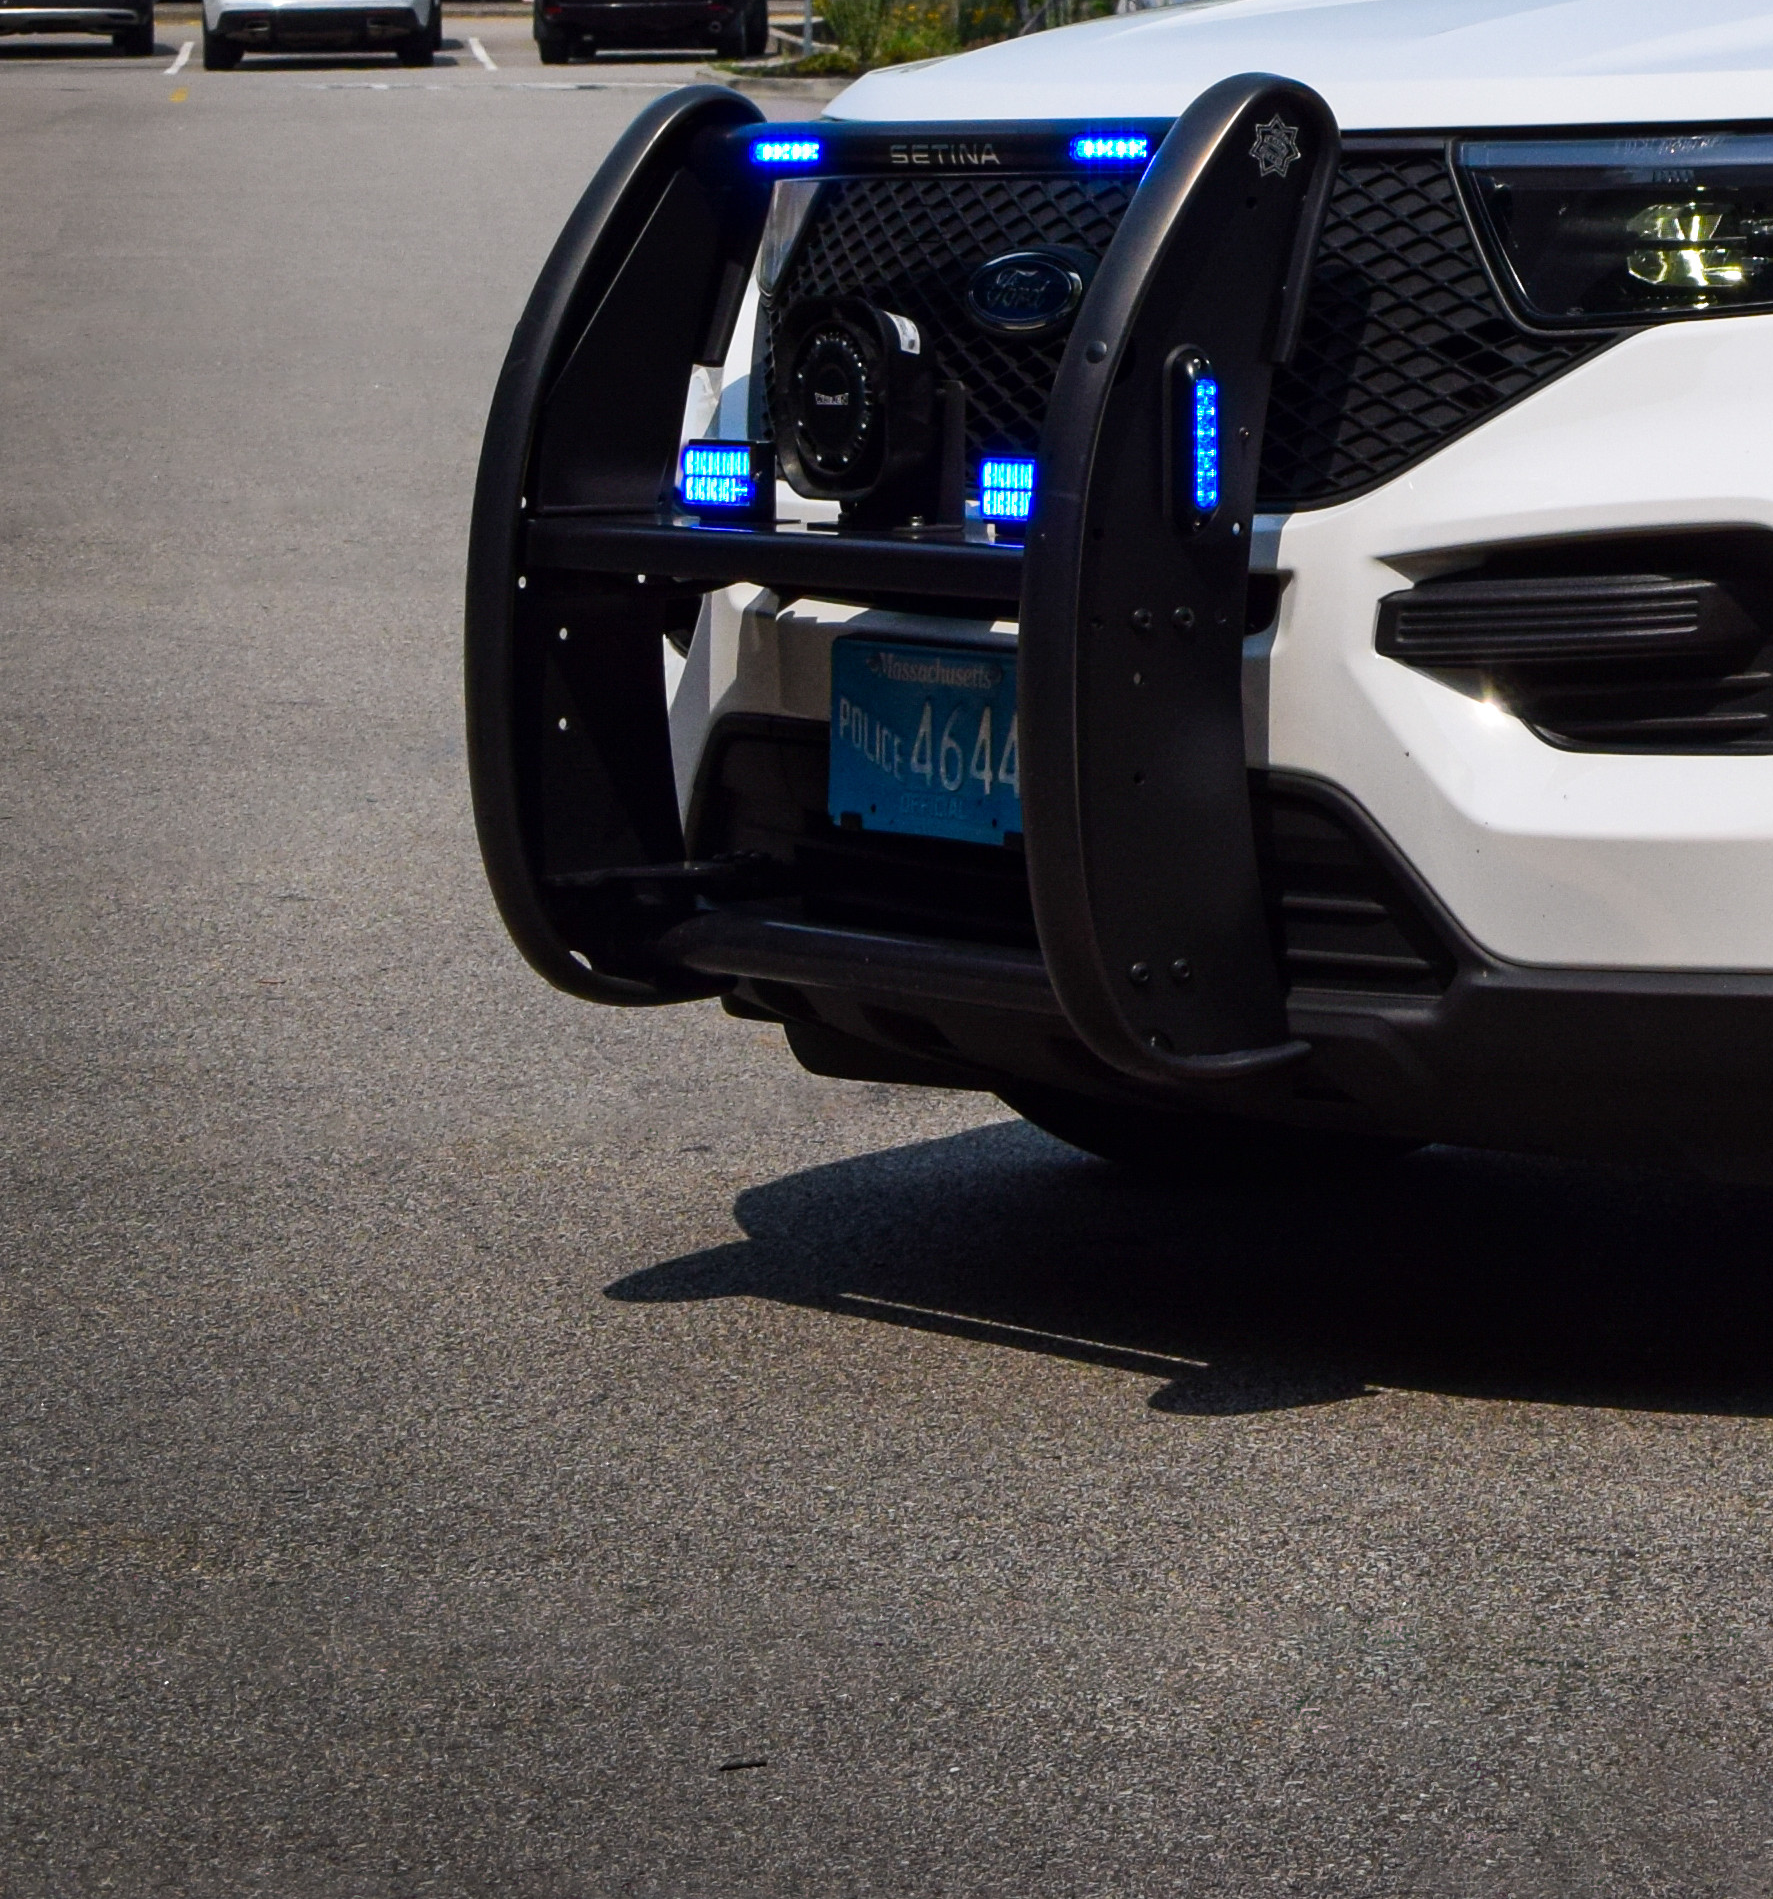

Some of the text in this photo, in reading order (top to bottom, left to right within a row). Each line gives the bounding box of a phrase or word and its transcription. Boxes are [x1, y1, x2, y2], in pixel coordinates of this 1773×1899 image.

[890, 144, 1000, 164] SETINA
[878, 652, 992, 690] Massachusetts
[839, 698, 1019, 798] POLICE 4644
